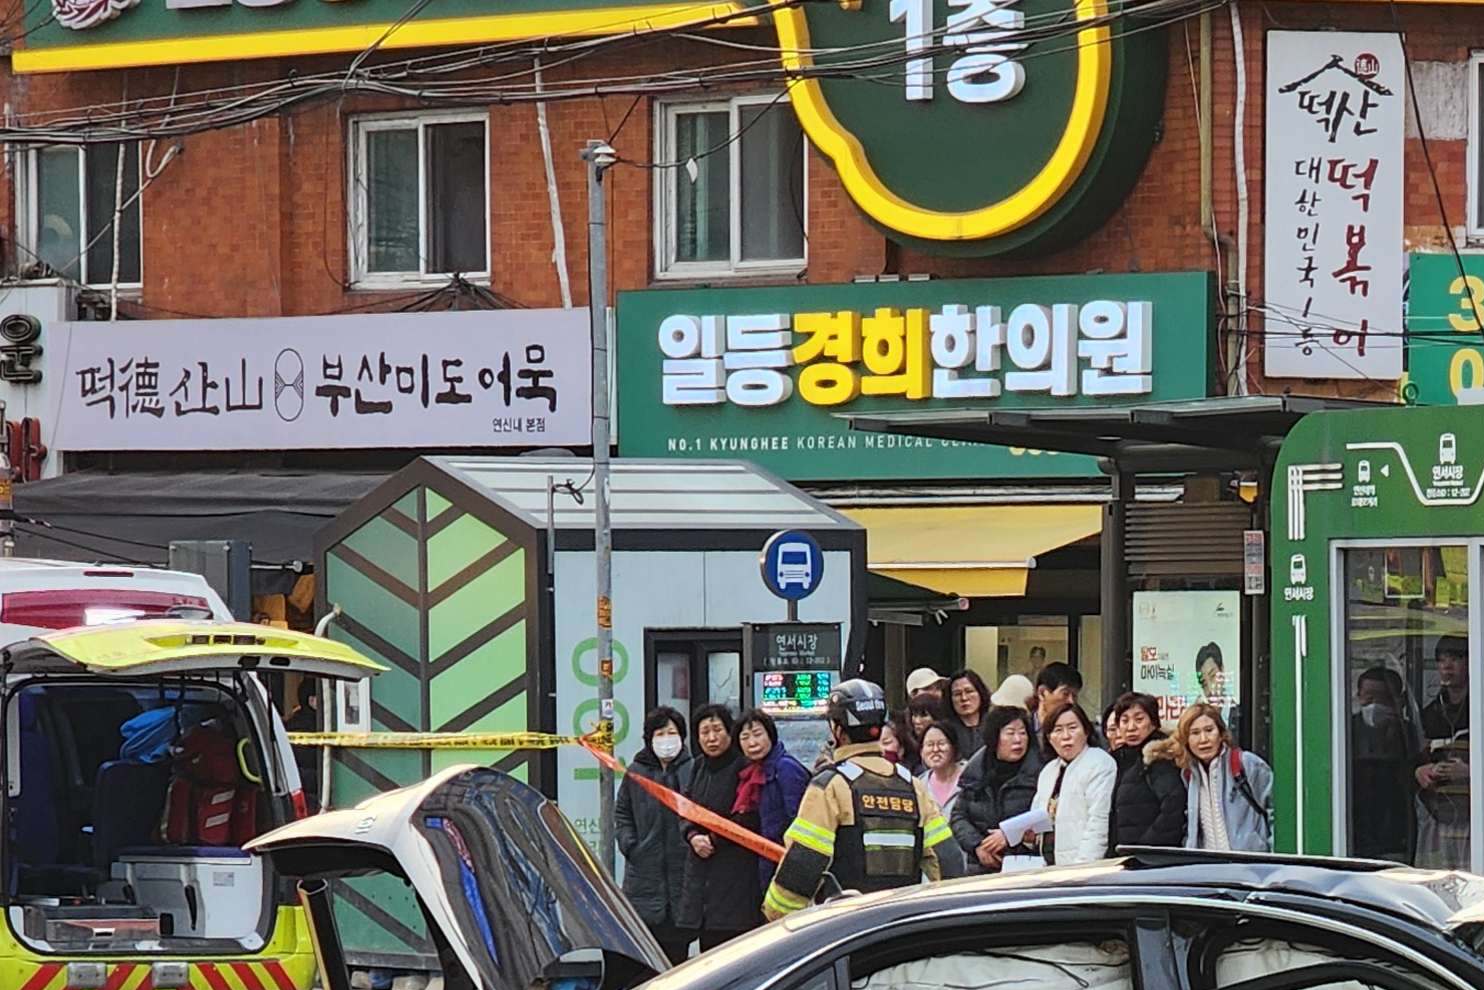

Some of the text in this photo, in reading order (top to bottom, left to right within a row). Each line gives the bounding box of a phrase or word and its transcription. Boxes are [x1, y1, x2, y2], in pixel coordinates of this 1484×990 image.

[657, 300, 1153, 407] 일등경희한의원
[315, 344, 557, 418] 부산미도어묵
[492, 417, 546, 433] 연신내 본점
[667, 438, 701, 452] NO.1
[709, 437, 789, 451] KYUNGHEE
[797, 435, 857, 449] KOREAN
[864, 434, 933, 449] MEDICAL
[776, 632, 818, 652] 연서시장
[861, 794, 914, 813] 안전담당
